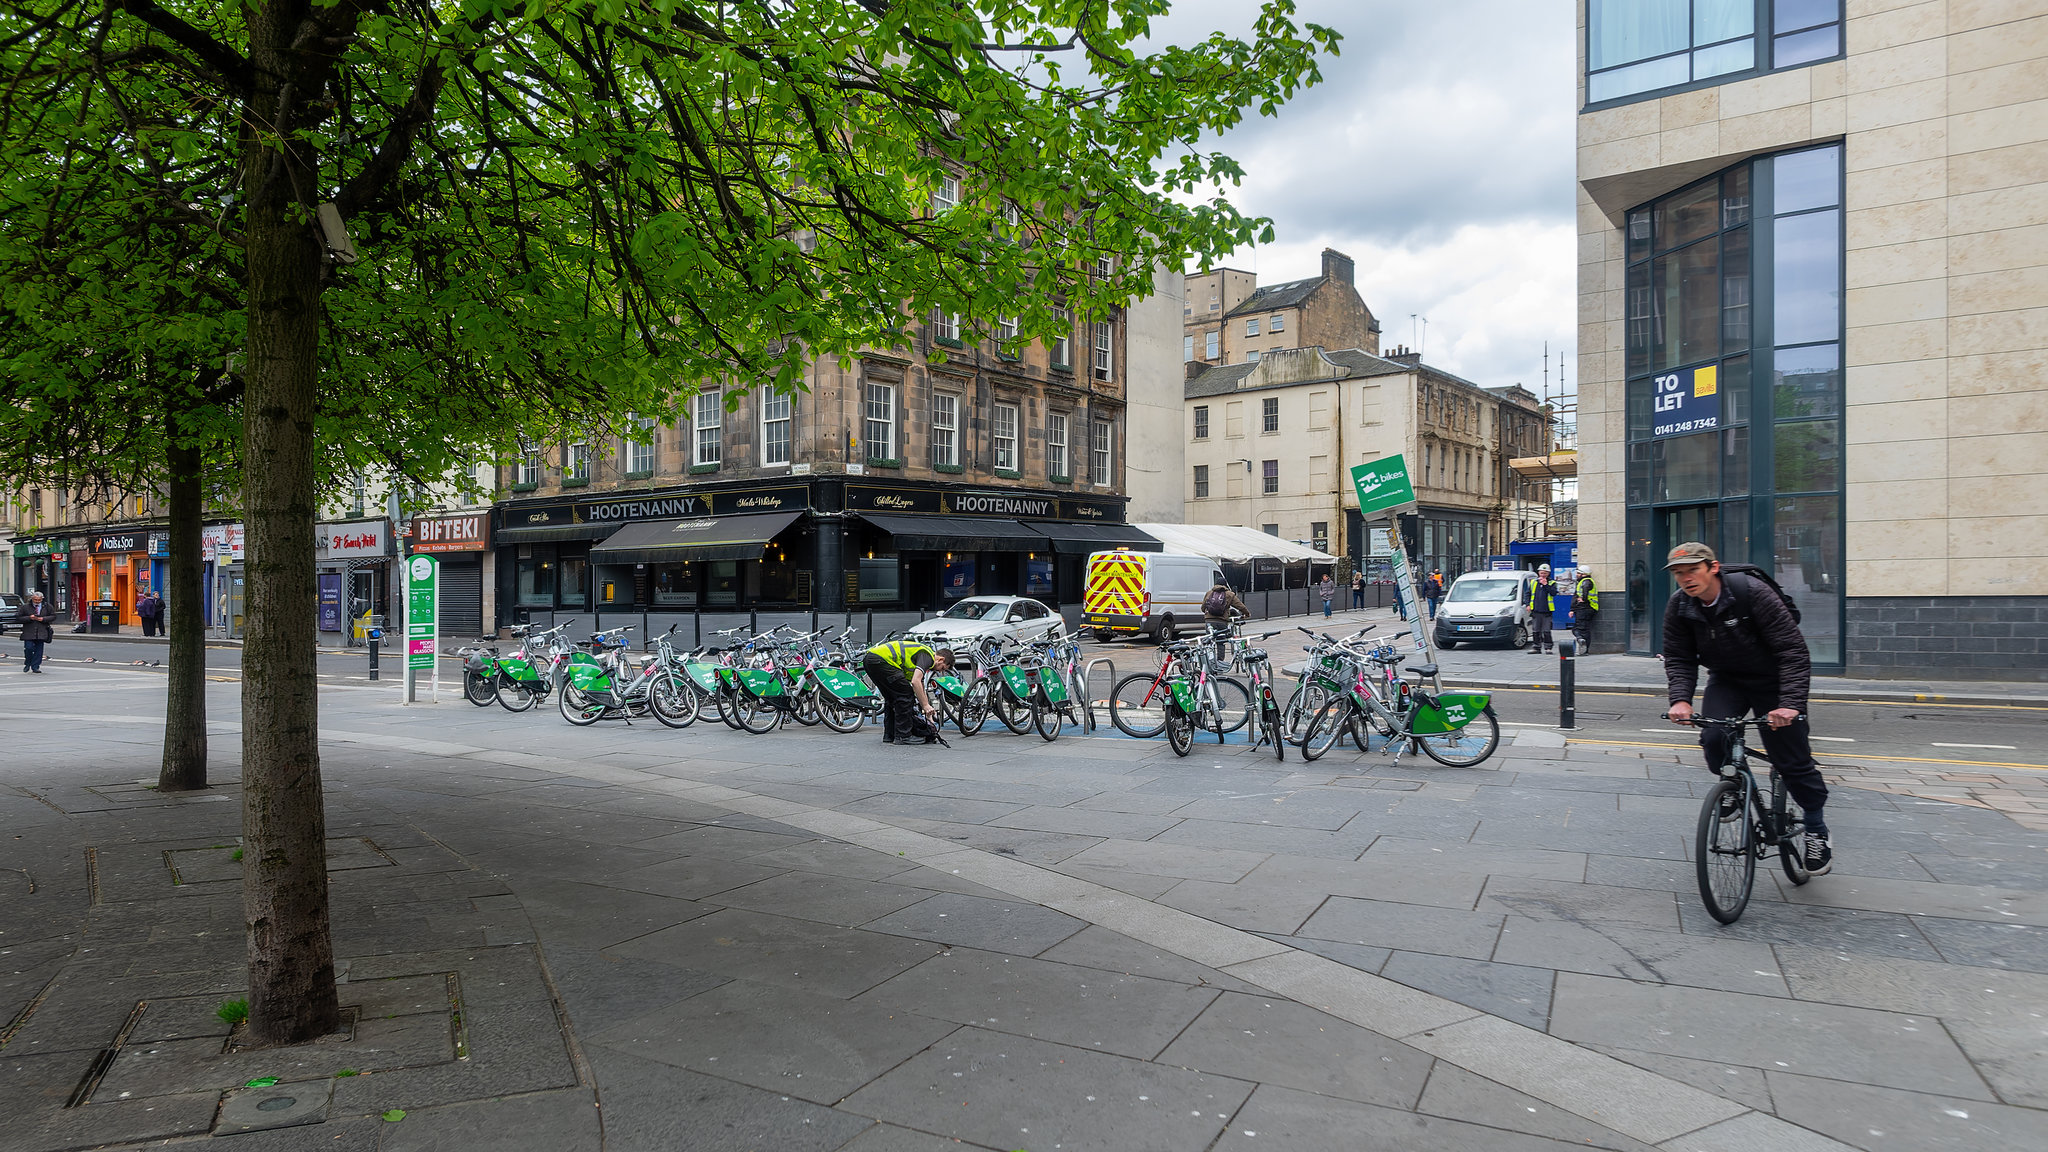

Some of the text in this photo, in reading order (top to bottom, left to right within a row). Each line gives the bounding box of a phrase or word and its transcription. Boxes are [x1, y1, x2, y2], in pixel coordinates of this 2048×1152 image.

[1655, 374, 1679, 393] TO
[1655, 391, 1685, 413] LET
[1655, 417, 1717, 435] 0141 248 7342
[1380, 470, 1404, 483] bikes
[589, 497, 696, 520] HOOTENANNY
[956, 496, 1048, 515] HOOTENANNY
[420, 517, 479, 541] BIFTEKI
